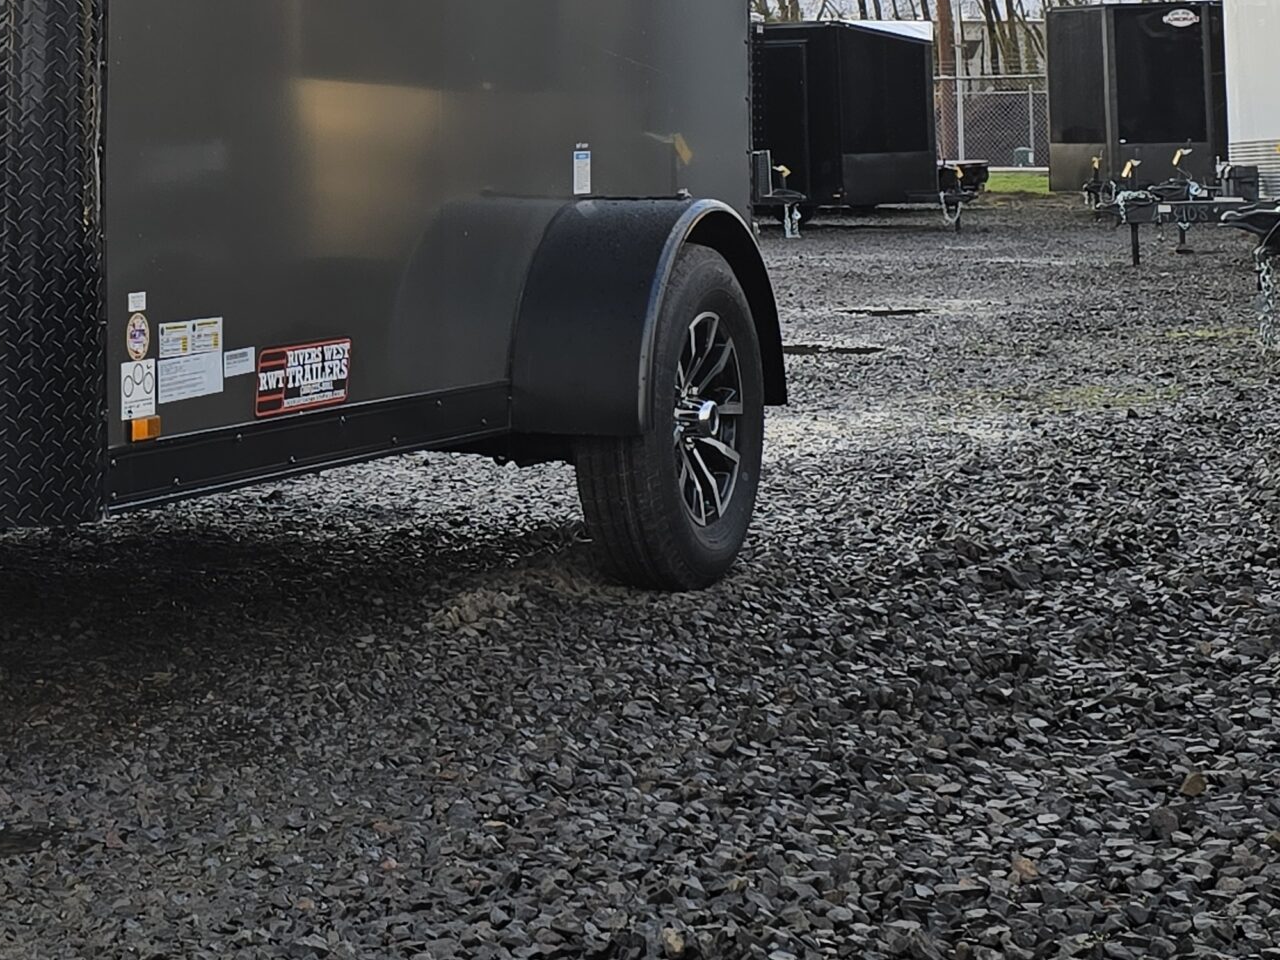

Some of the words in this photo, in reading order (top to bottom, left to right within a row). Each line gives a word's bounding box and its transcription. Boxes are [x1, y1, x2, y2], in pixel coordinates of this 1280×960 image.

[286, 347, 322, 367] RIVERS
[323, 342, 350, 361] WEST
[258, 370, 285, 391] RWT
[286, 359, 348, 389] TRAILERS
